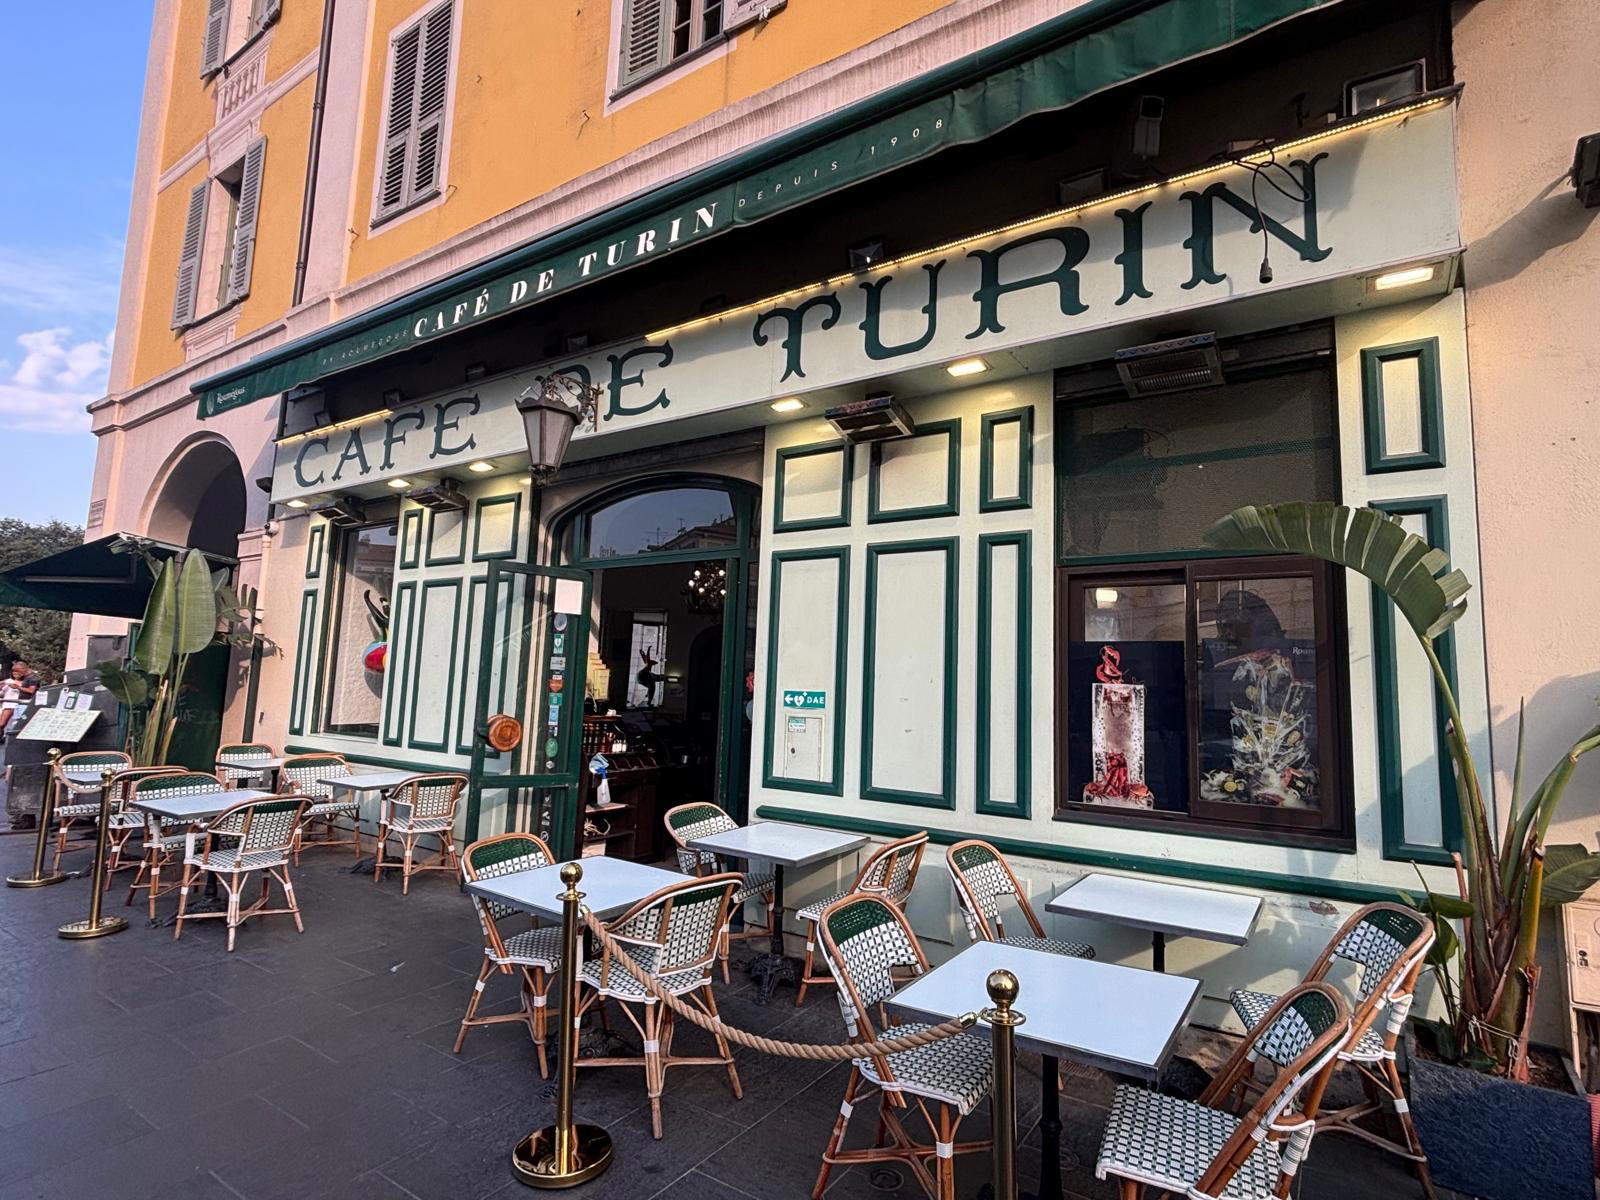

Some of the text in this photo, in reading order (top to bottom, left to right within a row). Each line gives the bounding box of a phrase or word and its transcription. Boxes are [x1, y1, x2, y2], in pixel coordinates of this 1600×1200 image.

[870, 118, 943, 155] 1908
[738, 160, 838, 208] DEPUIS
[413, 202, 719, 338] CAFÉ DE TURIN
[293, 392, 481, 488] CAFE
[752, 151, 1333, 384] TURIN
[806, 696, 825, 704] DAE
